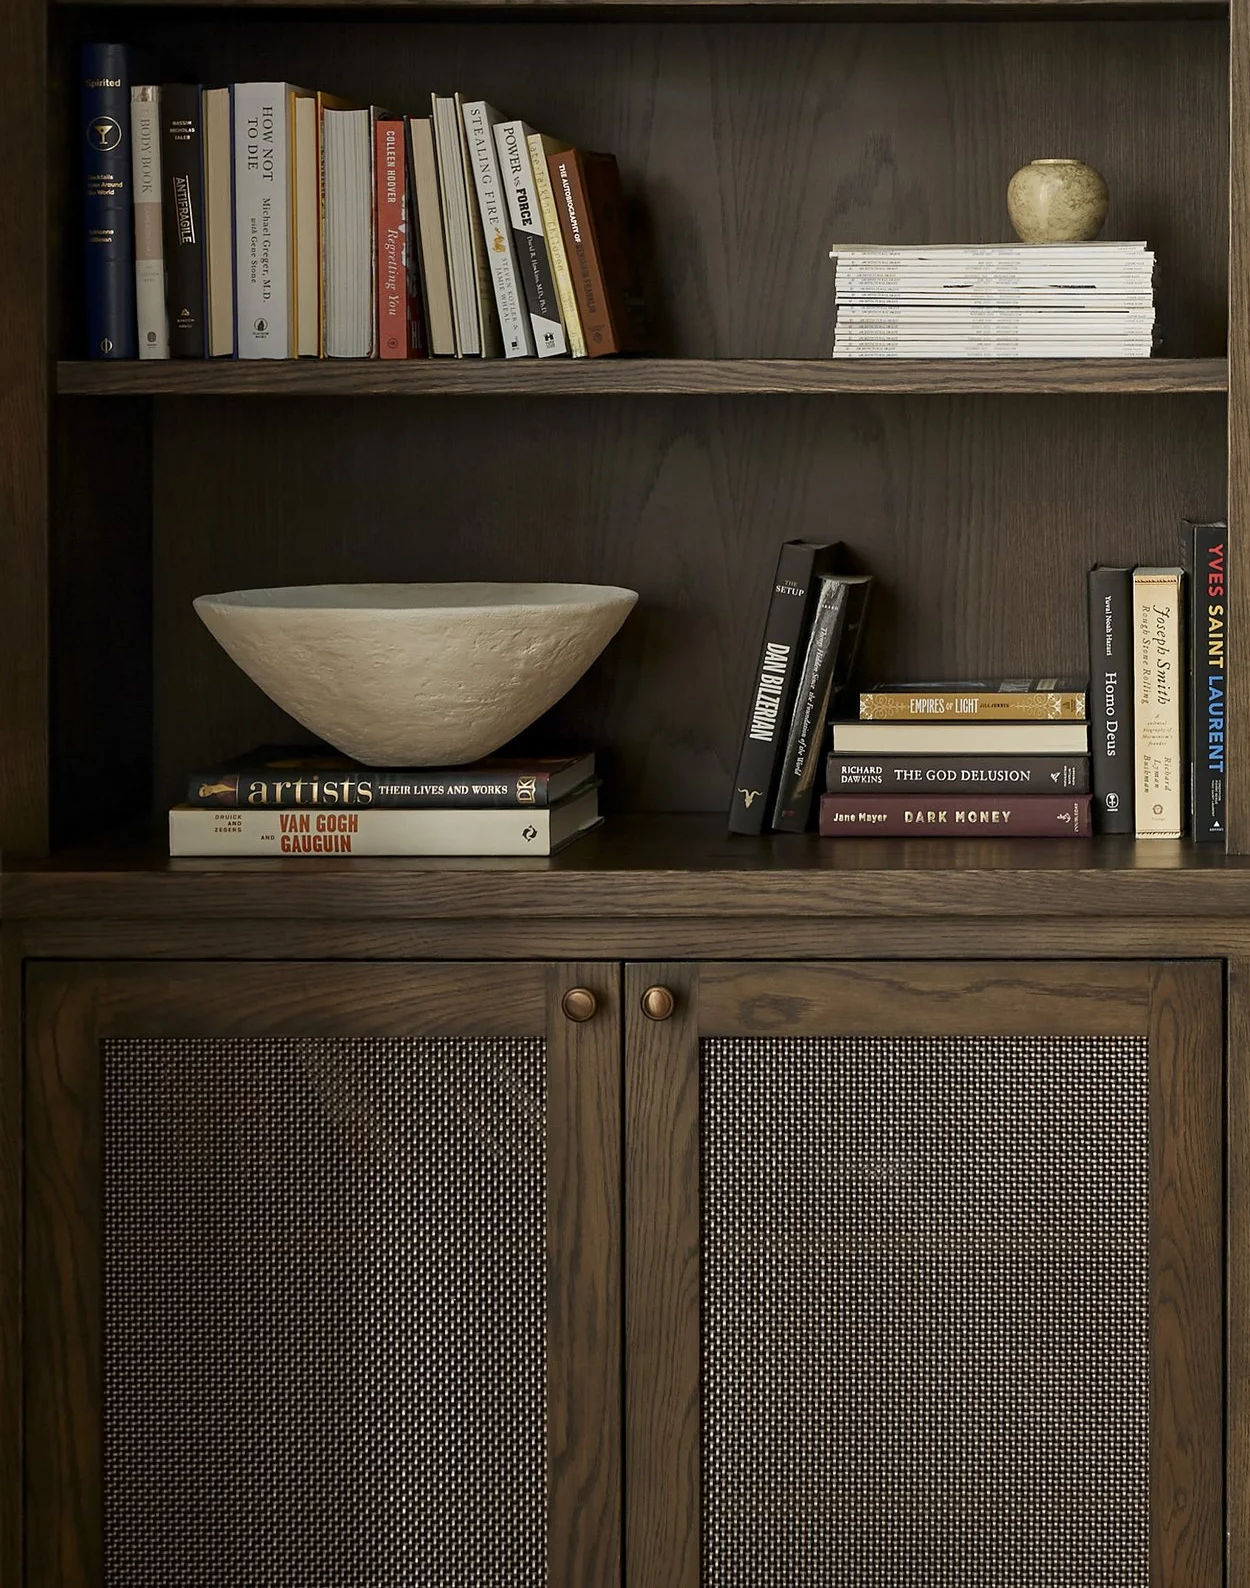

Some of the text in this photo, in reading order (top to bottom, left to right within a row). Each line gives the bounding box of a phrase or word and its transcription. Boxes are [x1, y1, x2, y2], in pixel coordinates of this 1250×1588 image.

[246, 116, 259, 171] TO DIE
[261, 106, 274, 182] HOW NOT
[386, 130, 397, 203] COLLEEN HOOVER
[470, 108, 500, 226] STEALING FIRE
[174, 175, 193, 244] ANTIFRAGILE
[384, 228, 399, 316] Regretting You
[775, 584, 806, 598] SETUP
[1207, 542, 1225, 598] YVES
[1207, 603, 1224, 669] SAINT
[749, 641, 791, 743] DAN BILZERIAN
[909, 697, 980, 715] EMPIRES OF LIGHT
[1104, 671, 1120, 757] Homo Deus
[1207, 674, 1224, 773] LAURENT
[377, 785, 509, 795] THEIR LIVES AND WORKS
[840, 765, 883, 775] RICHARD
[840, 775, 884, 785] DAWKINS
[893, 768, 1032, 782] THE GOD DELUSION
[246, 777, 374, 806] artists
[278, 813, 359, 833] VAN GOGH
[832, 811, 889, 824] Jane Mayer
[903, 810, 1012, 823] DARK MONEY
[279, 834, 352, 854] GAUGUIN
